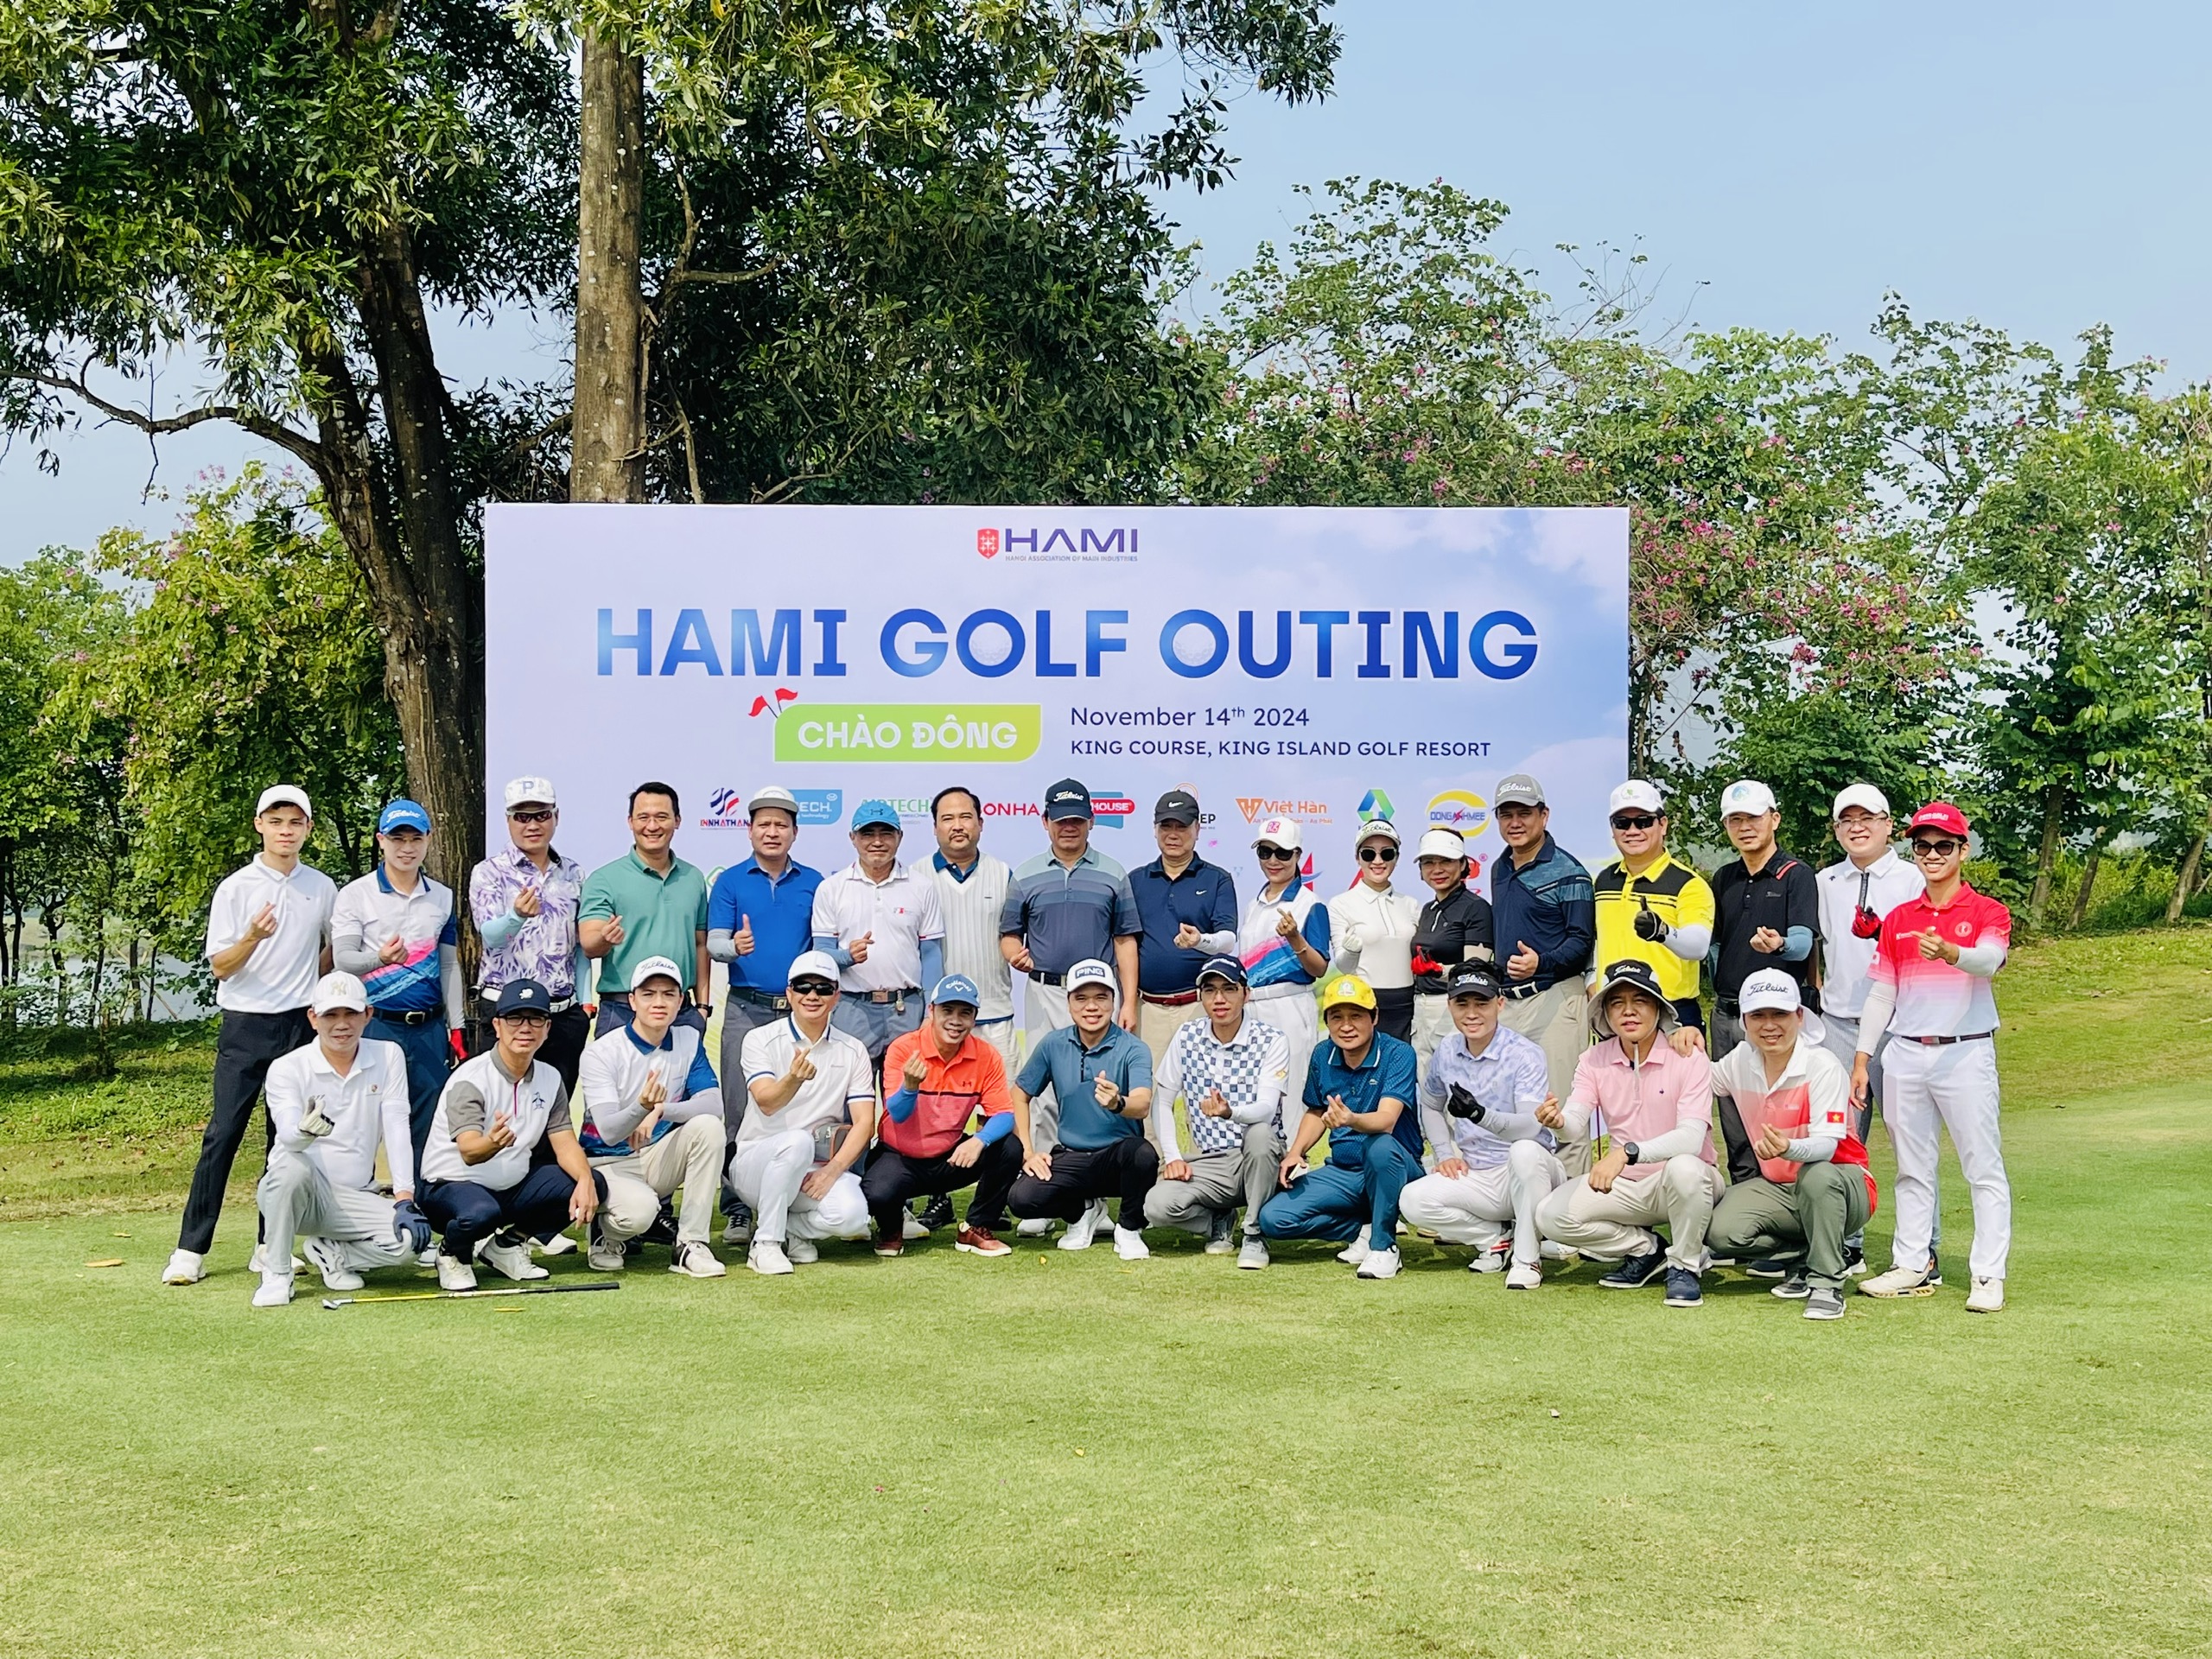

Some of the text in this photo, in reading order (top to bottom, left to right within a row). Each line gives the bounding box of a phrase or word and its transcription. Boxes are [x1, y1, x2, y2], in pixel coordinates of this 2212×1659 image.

[1005, 529, 1138, 552] HAMI
[597, 608, 1538, 680] HAMI GOLF OUTING
[1071, 707, 1310, 727] November 14th 2024
[798, 714, 1018, 749] CHÀO ĐÔNG
[1071, 741, 1491, 758] KING COURSE, KING ISLAND GOLF RESORT
[981, 803, 1040, 816] ONHA
[1090, 802, 1129, 811] HOUSE
[1263, 798, 1327, 817] Việt Hàn
[1077, 967, 1104, 976] PING
[1747, 981, 1789, 996] Titleist
